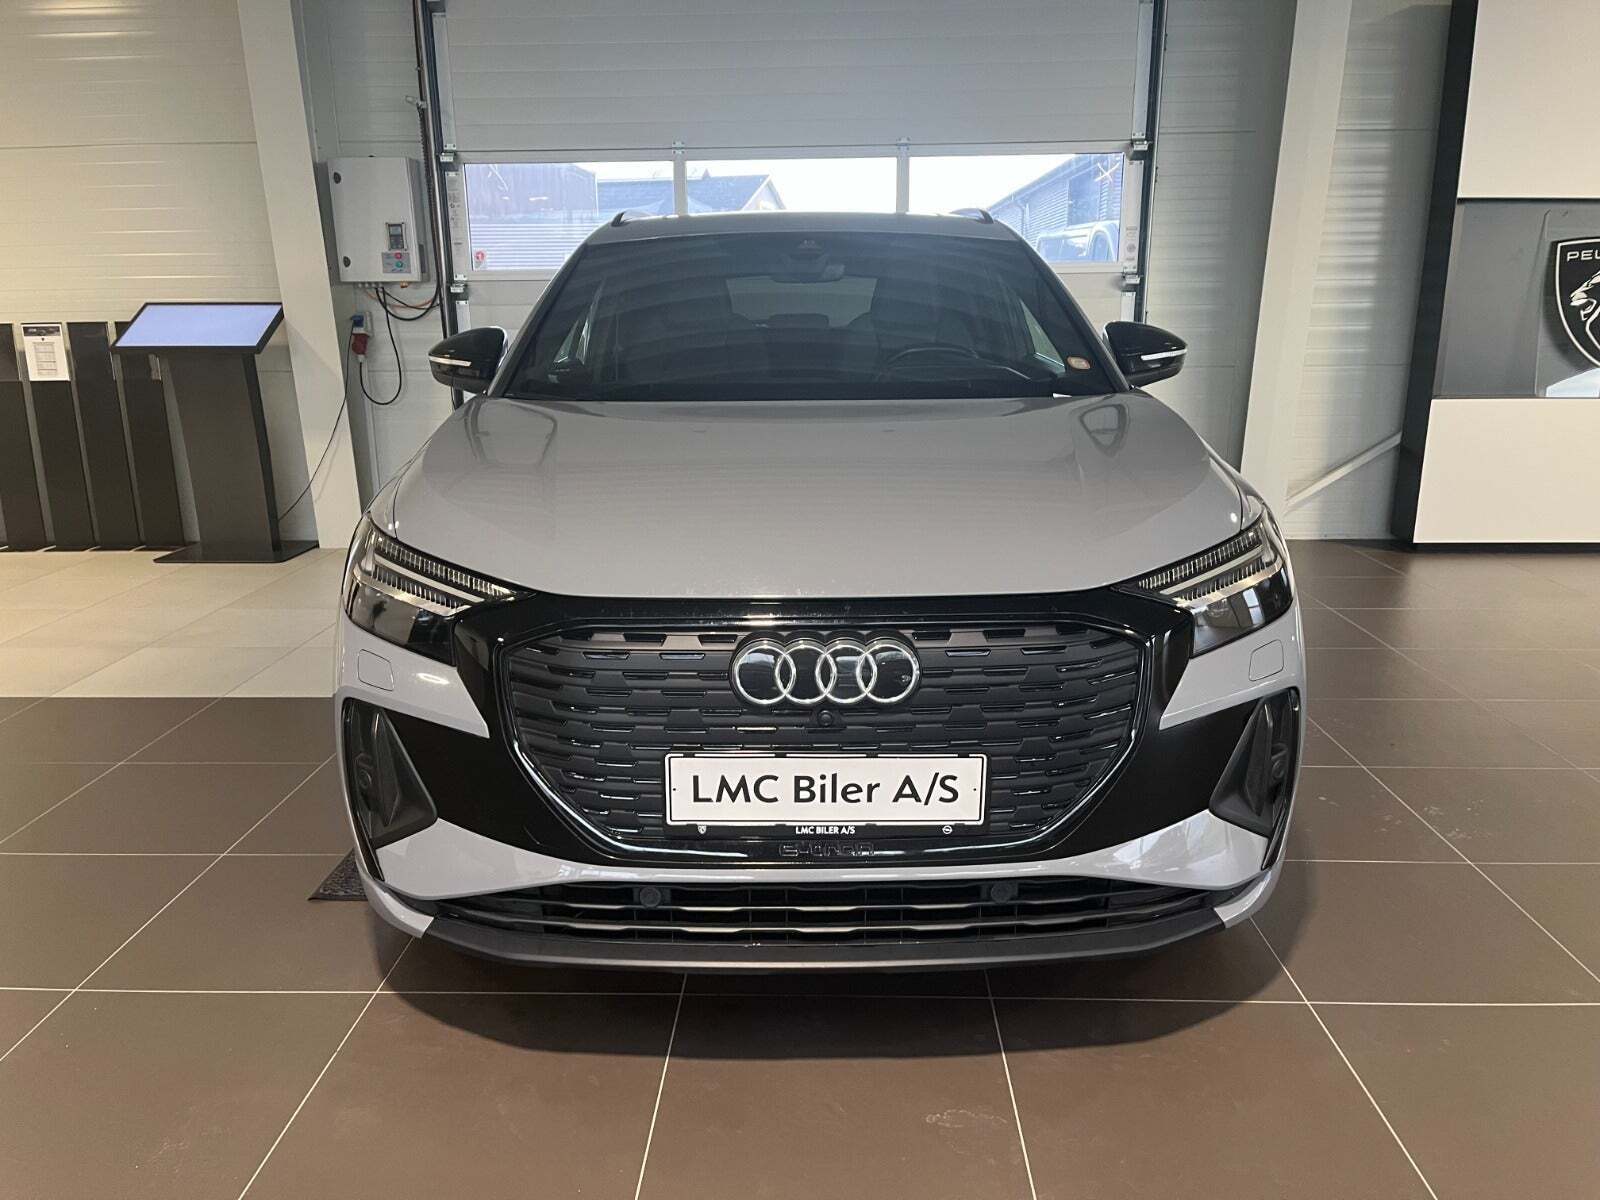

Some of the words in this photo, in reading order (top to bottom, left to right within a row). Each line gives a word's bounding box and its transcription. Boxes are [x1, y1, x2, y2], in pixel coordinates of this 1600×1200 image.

[692, 774, 779, 803] LMC
[793, 773, 881, 803] Biler
[892, 772, 959, 805] A/S
[795, 826, 814, 834] LMC
[815, 826, 839, 834] BILER
[840, 825, 855, 834] A/S
